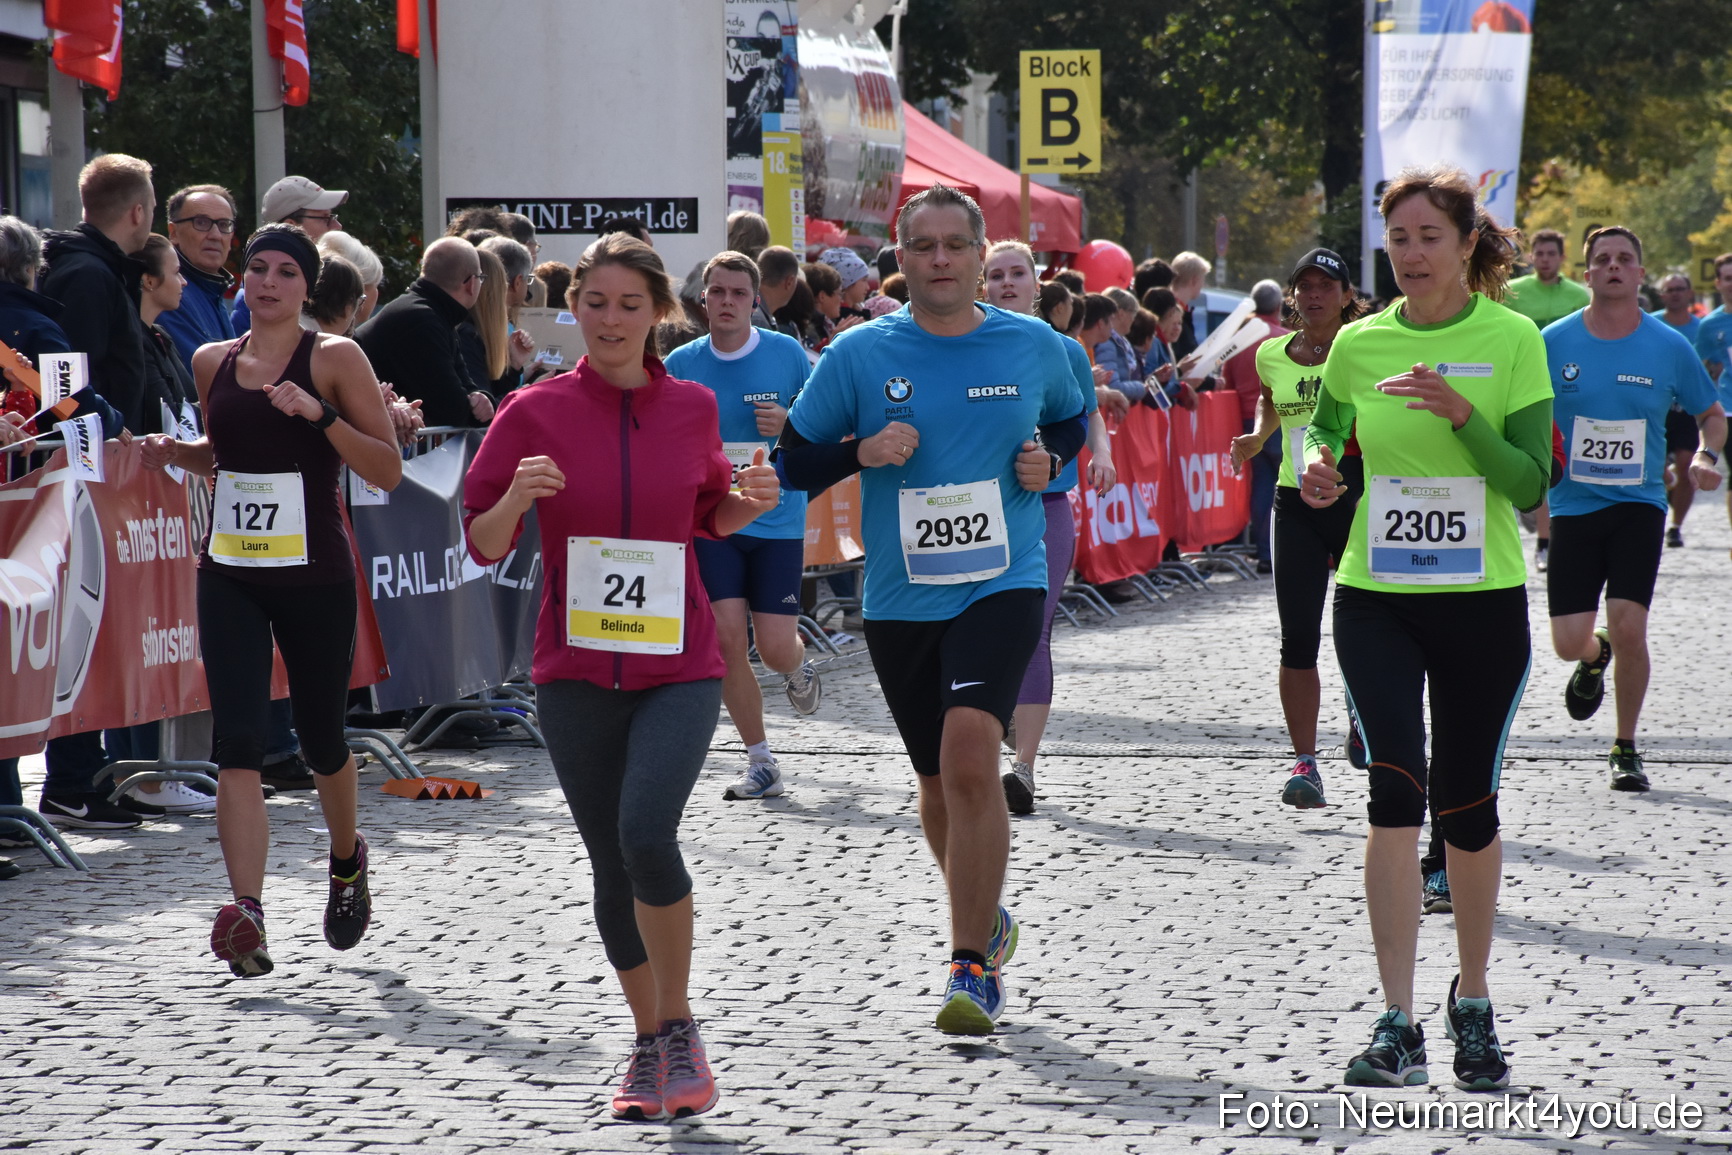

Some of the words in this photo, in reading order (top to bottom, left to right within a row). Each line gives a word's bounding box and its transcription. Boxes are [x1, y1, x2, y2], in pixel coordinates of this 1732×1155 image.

[743, 53, 760, 67] CUP
[1381, 47, 1408, 63] FÜR
[1030, 55, 1091, 77] Block
[1041, 88, 1081, 147] B
[766, 151, 789, 174] 18.
[727, 171, 758, 181] ENBERG
[1576, 205, 1613, 218] Block
[886, 377, 911, 387] BMW
[1617, 374, 1653, 385] BOCK
[743, 392, 779, 402] BOCK
[967, 385, 1019, 398] BOCK
[885, 406, 915, 415] PARTL
[885, 413, 915, 421] Neumarkt
[1582, 438, 1634, 460] 2376
[1589, 465, 1623, 474] Christian
[241, 482, 273, 491] BOCK
[1412, 487, 1451, 497] BOCK
[936, 493, 972, 505] BOCK
[232, 502, 280, 530] 127
[116, 530, 130, 563] die
[125, 501, 188, 563] meisten
[915, 512, 992, 548] 2932
[1385, 509, 1467, 543] 2305
[241, 540, 269, 551] Laura
[612, 549, 654, 561] BOCK
[1411, 554, 1438, 566] Ruth
[603, 573, 646, 609] 24
[601, 618, 645, 633] Belinda
[141, 616, 194, 669] schönsten
